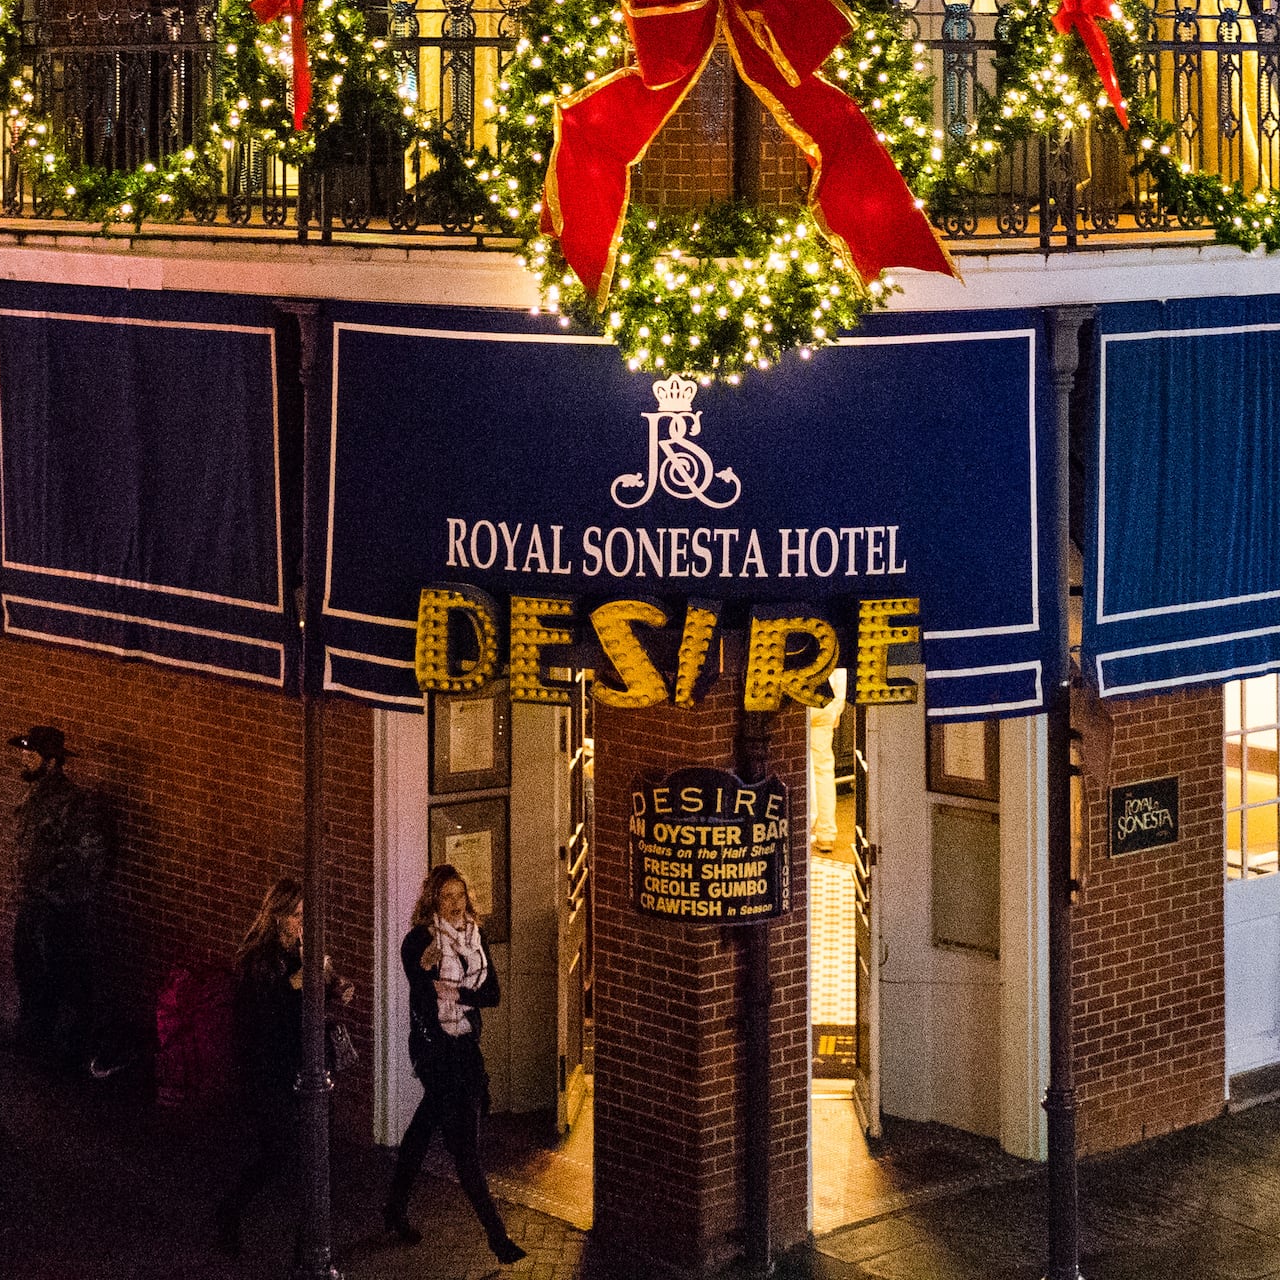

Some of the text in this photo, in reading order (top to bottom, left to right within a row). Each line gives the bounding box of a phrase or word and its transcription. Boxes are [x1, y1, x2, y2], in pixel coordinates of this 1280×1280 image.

[446, 518, 907, 578] ROYAL SONESTA HOTEL
[415, 582, 921, 712] DESIRE
[632, 787, 783, 820] DESIRE
[1125, 797, 1153, 817] ROYAL
[629, 815, 789, 846] AN OYSTER BAR
[1118, 809, 1174, 840] SONESTA
[638, 840, 775, 859] Oysters on the Half Shell
[644, 857, 767, 880] FRESH SHRIMP
[782, 843, 790, 911] LIQUOR
[644, 875, 767, 898] CREOLE GUMBO
[640, 892, 773, 917] CRAWFISH in Season
